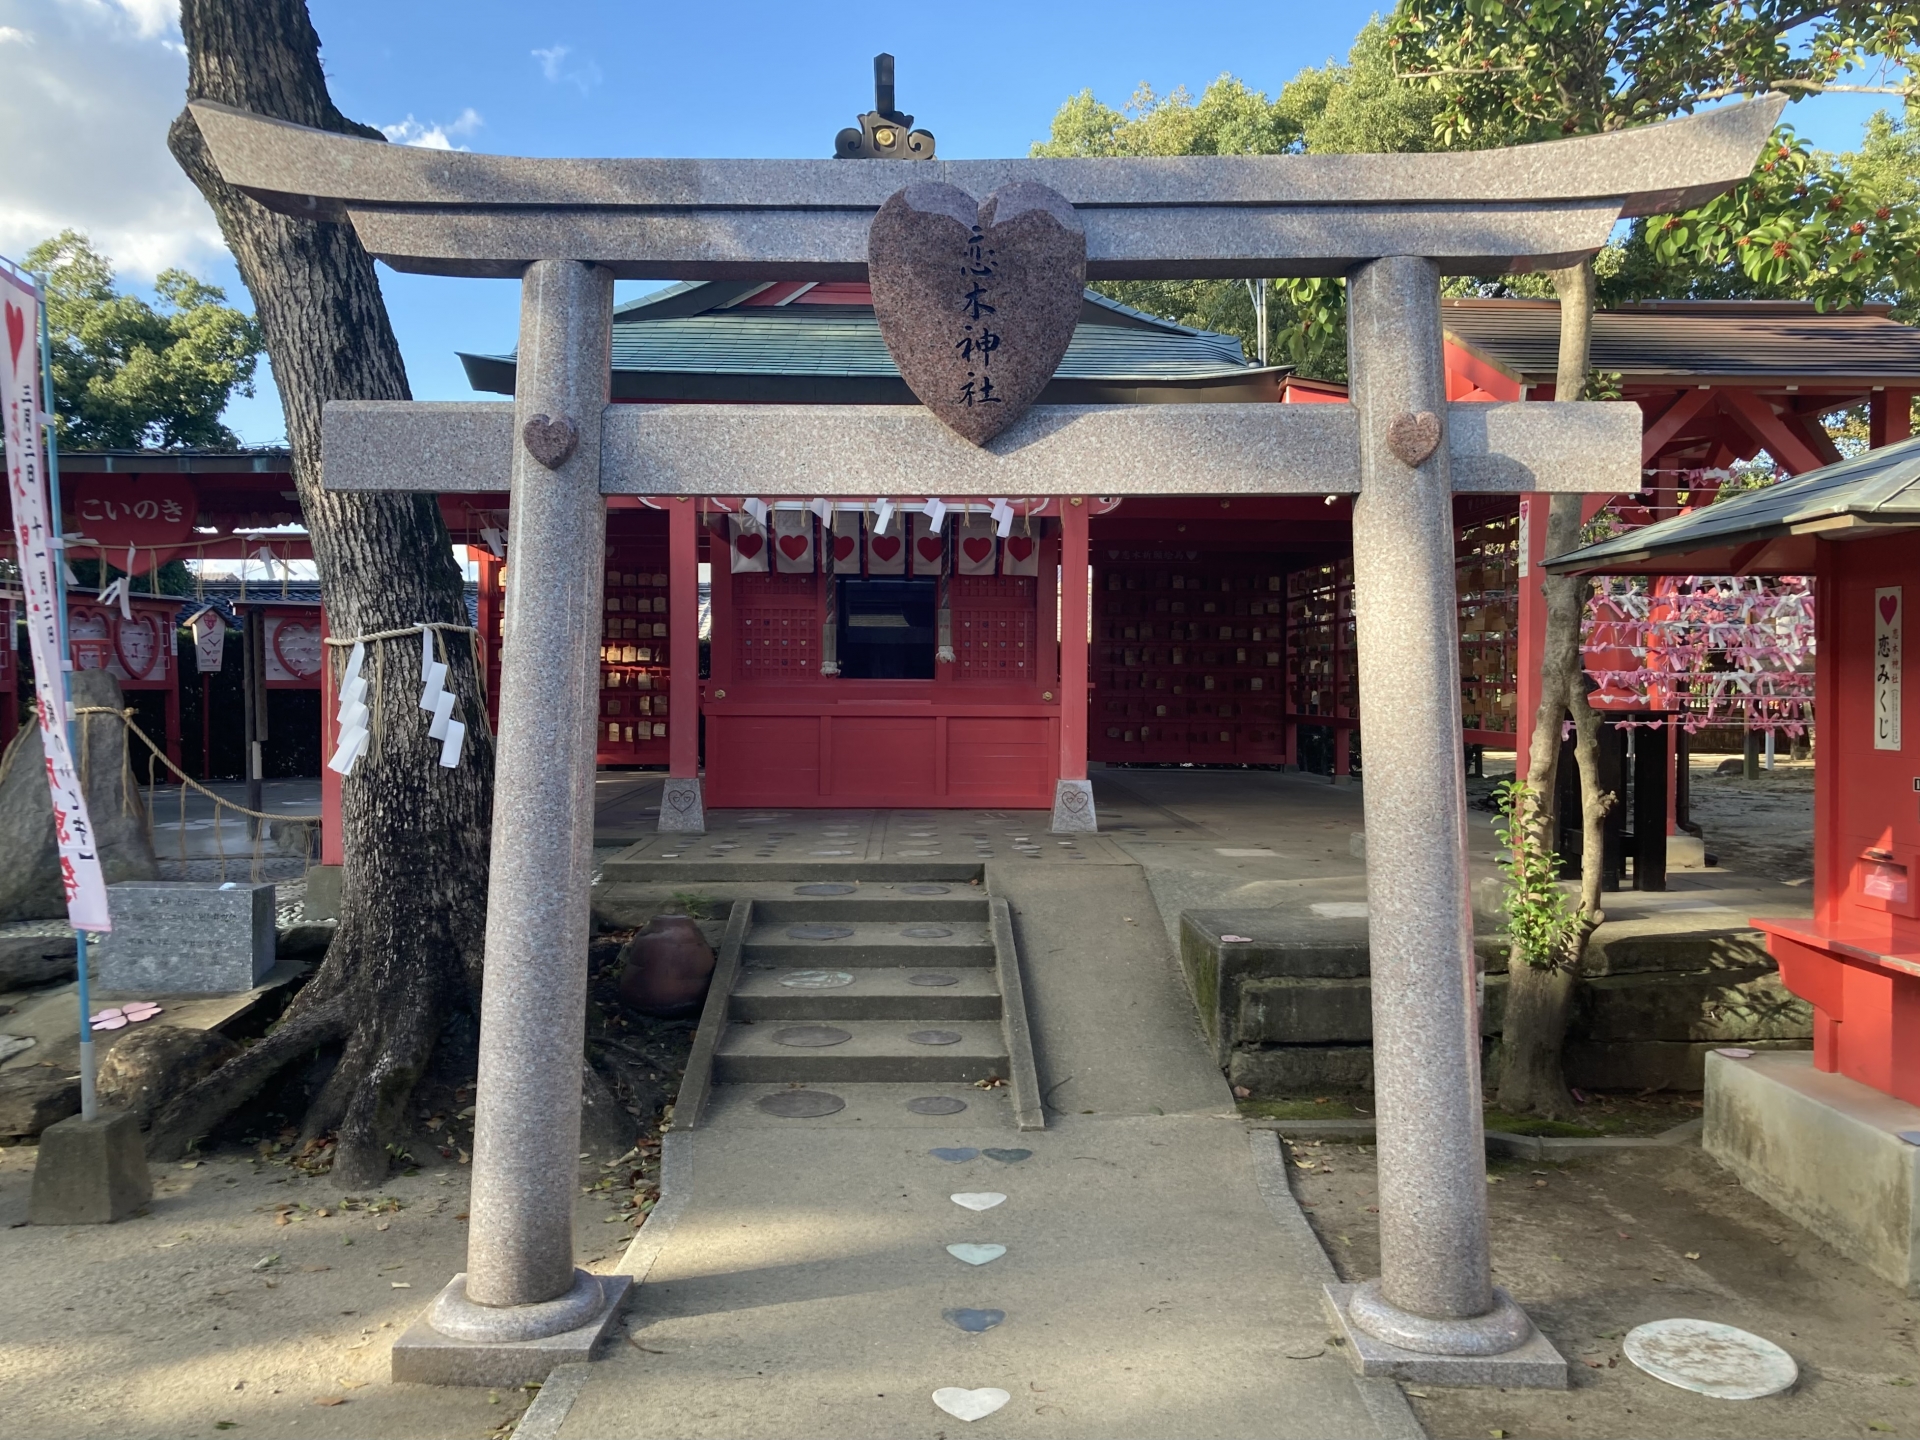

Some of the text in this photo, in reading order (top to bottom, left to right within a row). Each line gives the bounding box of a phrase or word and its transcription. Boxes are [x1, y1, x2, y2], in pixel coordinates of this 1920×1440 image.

[955, 224, 1002, 407] 恋木神社
[81, 498, 184, 522] こいのき
[1877, 634, 1891, 740] 恋みくじ
[1891, 628, 1899, 684] 恋木神社
